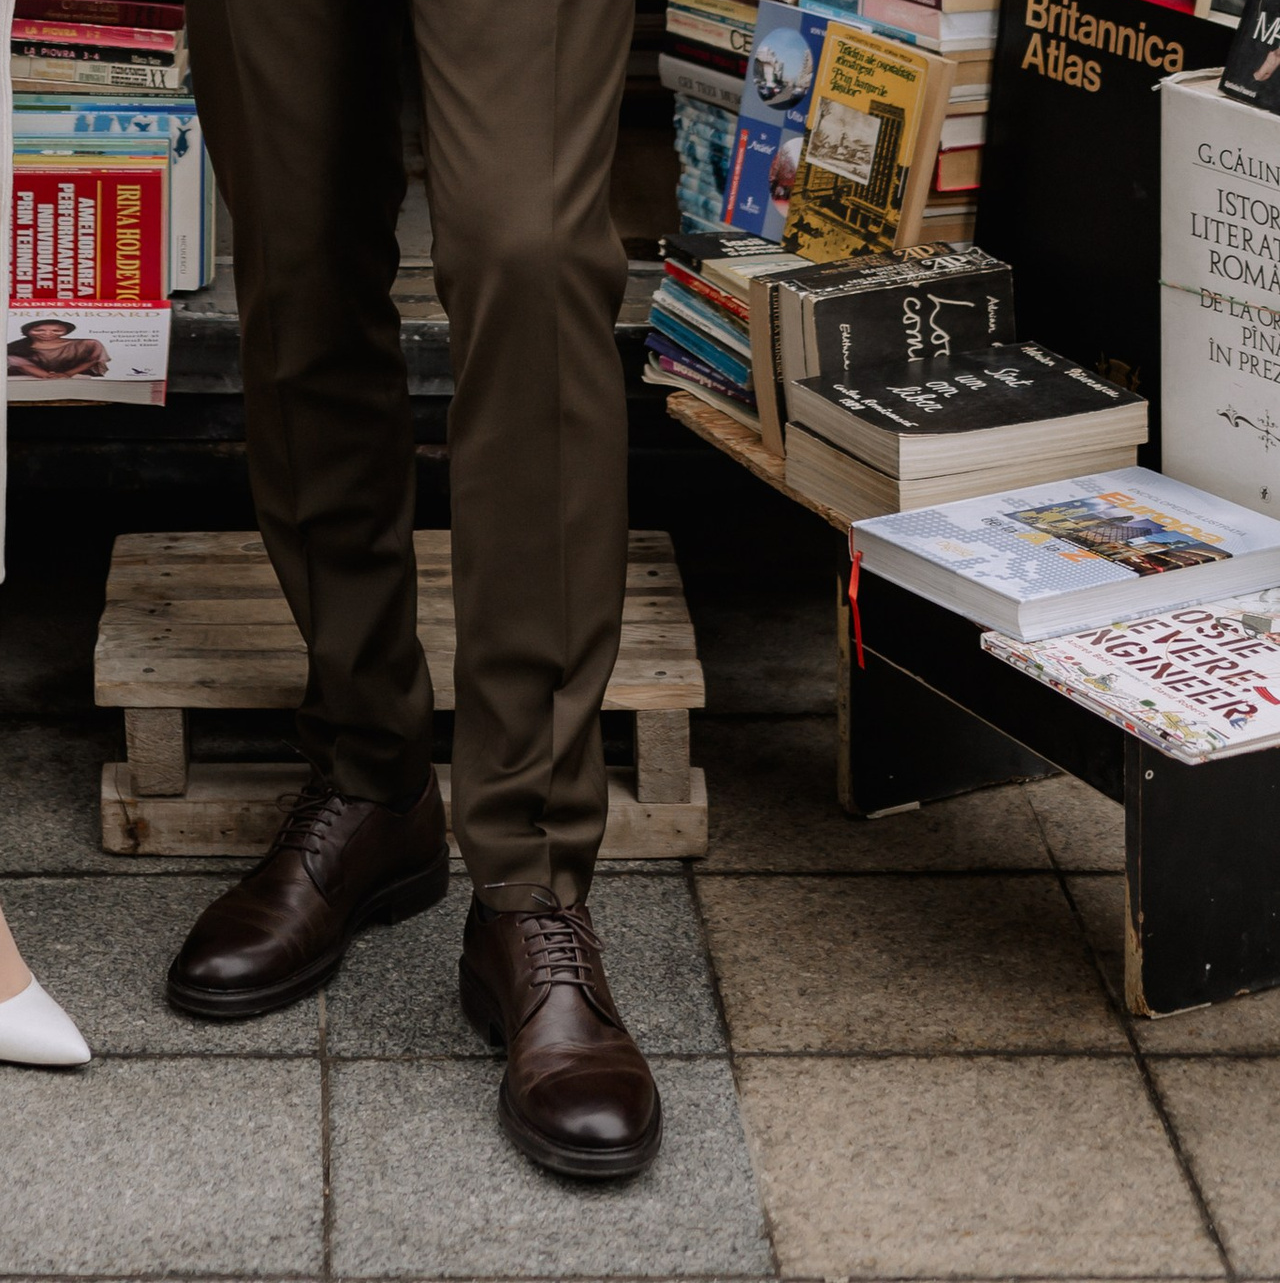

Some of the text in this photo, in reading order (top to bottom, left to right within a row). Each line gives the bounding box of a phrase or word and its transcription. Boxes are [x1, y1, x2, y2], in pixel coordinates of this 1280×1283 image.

[24, 27, 78, 37] LA PIOVRA
[24, 47, 100, 61] LA PIOVRA 3-4
[1021, 32, 1103, 93] Atlas
[1198, 143, 1216, 166] G.
[116, 185, 142, 226] IRINA
[16, 191, 34, 281] PRIN TEHNICI
[36, 203, 55, 289] INDIVIDUALE
[77, 197, 96, 297] AMELIORAREA
[1199, 287, 1254, 323] DE LA
[1208, 337, 1233, 367] ÎN
[886, 385, 944, 413] liber
[925, 380, 960, 399] om
[954, 374, 988, 391] un
[980, 516, 1000, 527] de
[1096, 491, 1224, 546] Europa
[1171, 609, 1278, 660] OSIE
[1064, 638, 1209, 719] Andrea Beaty David Roberts
[1076, 629, 1259, 720] NGINEER
